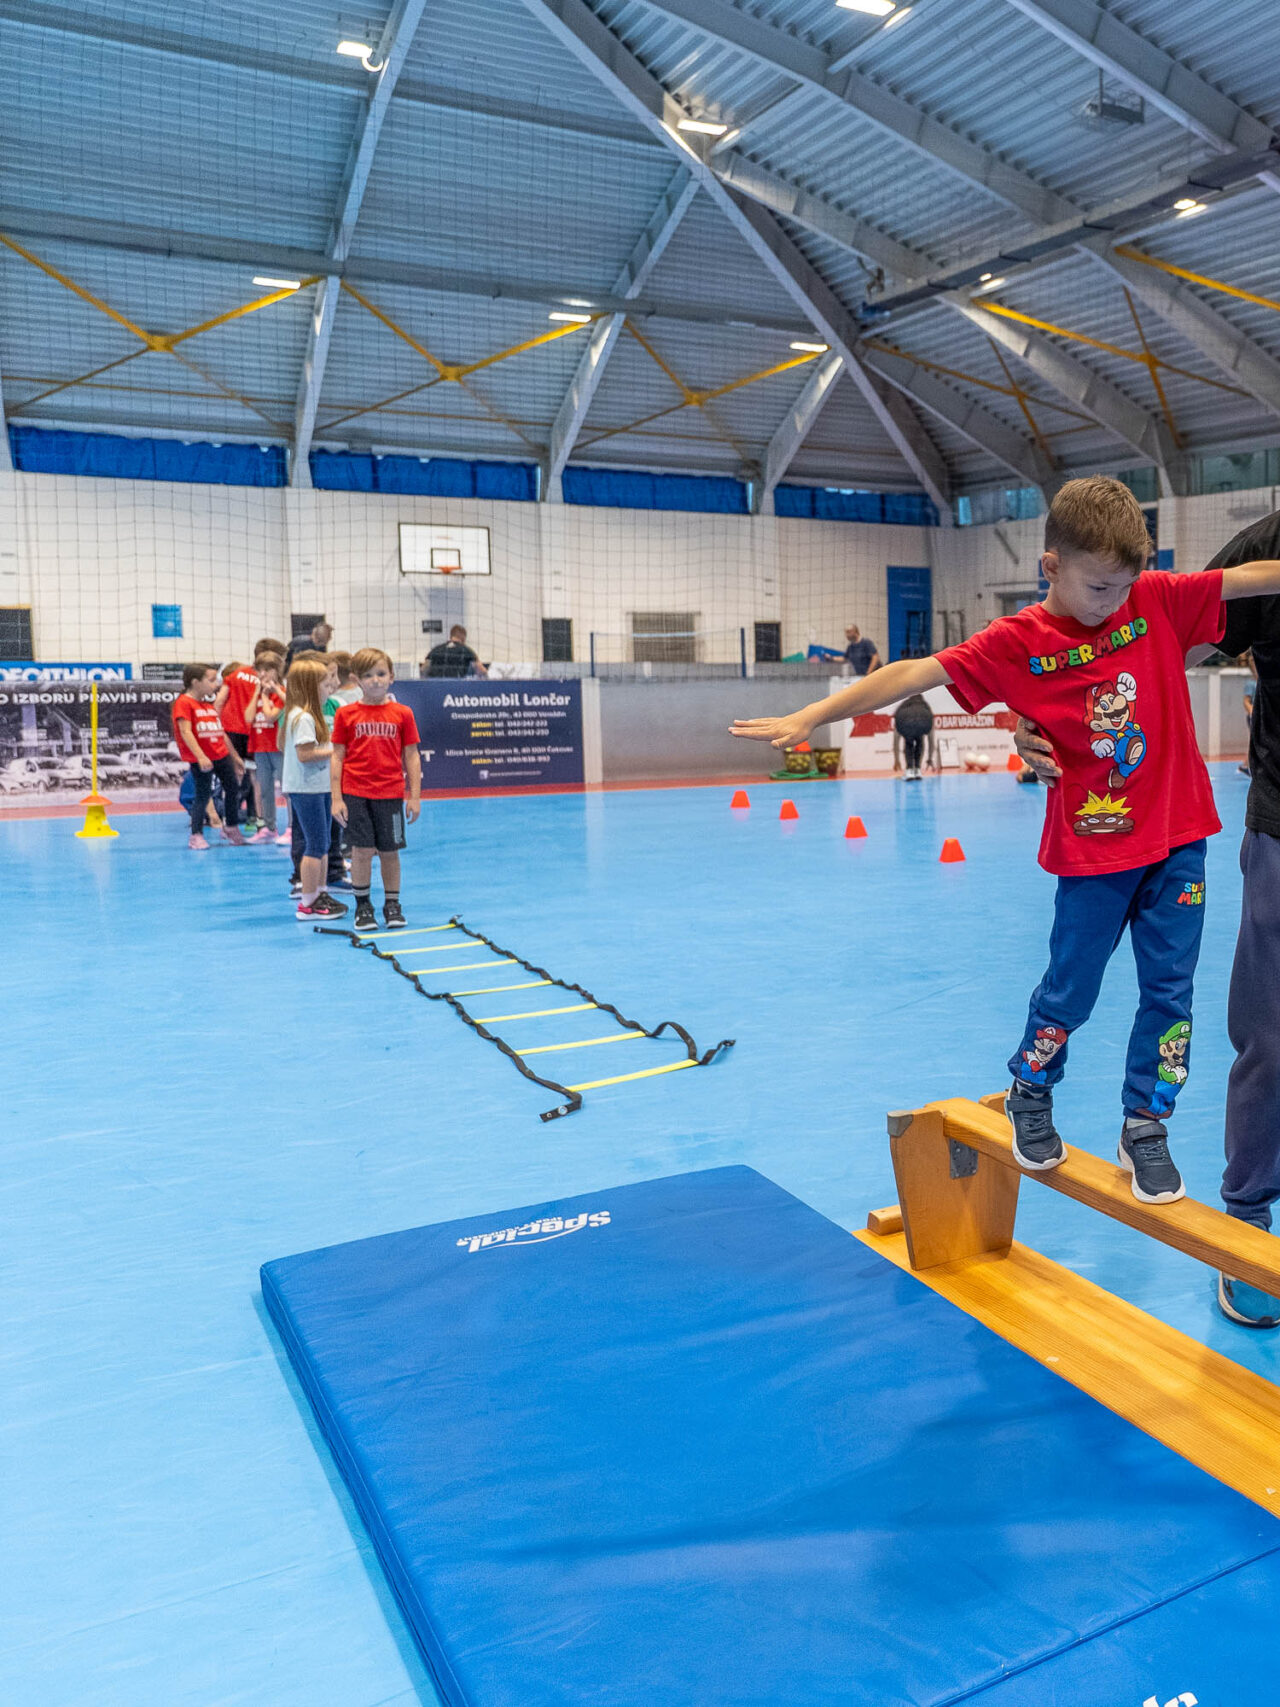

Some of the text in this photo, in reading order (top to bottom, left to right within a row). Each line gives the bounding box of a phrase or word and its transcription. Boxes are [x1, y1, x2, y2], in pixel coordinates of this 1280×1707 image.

[1029, 616, 1148, 676] SUPER MARIO
[12, 692, 75, 704] IZBORU
[443, 692, 571, 708] Automobil Lončar
